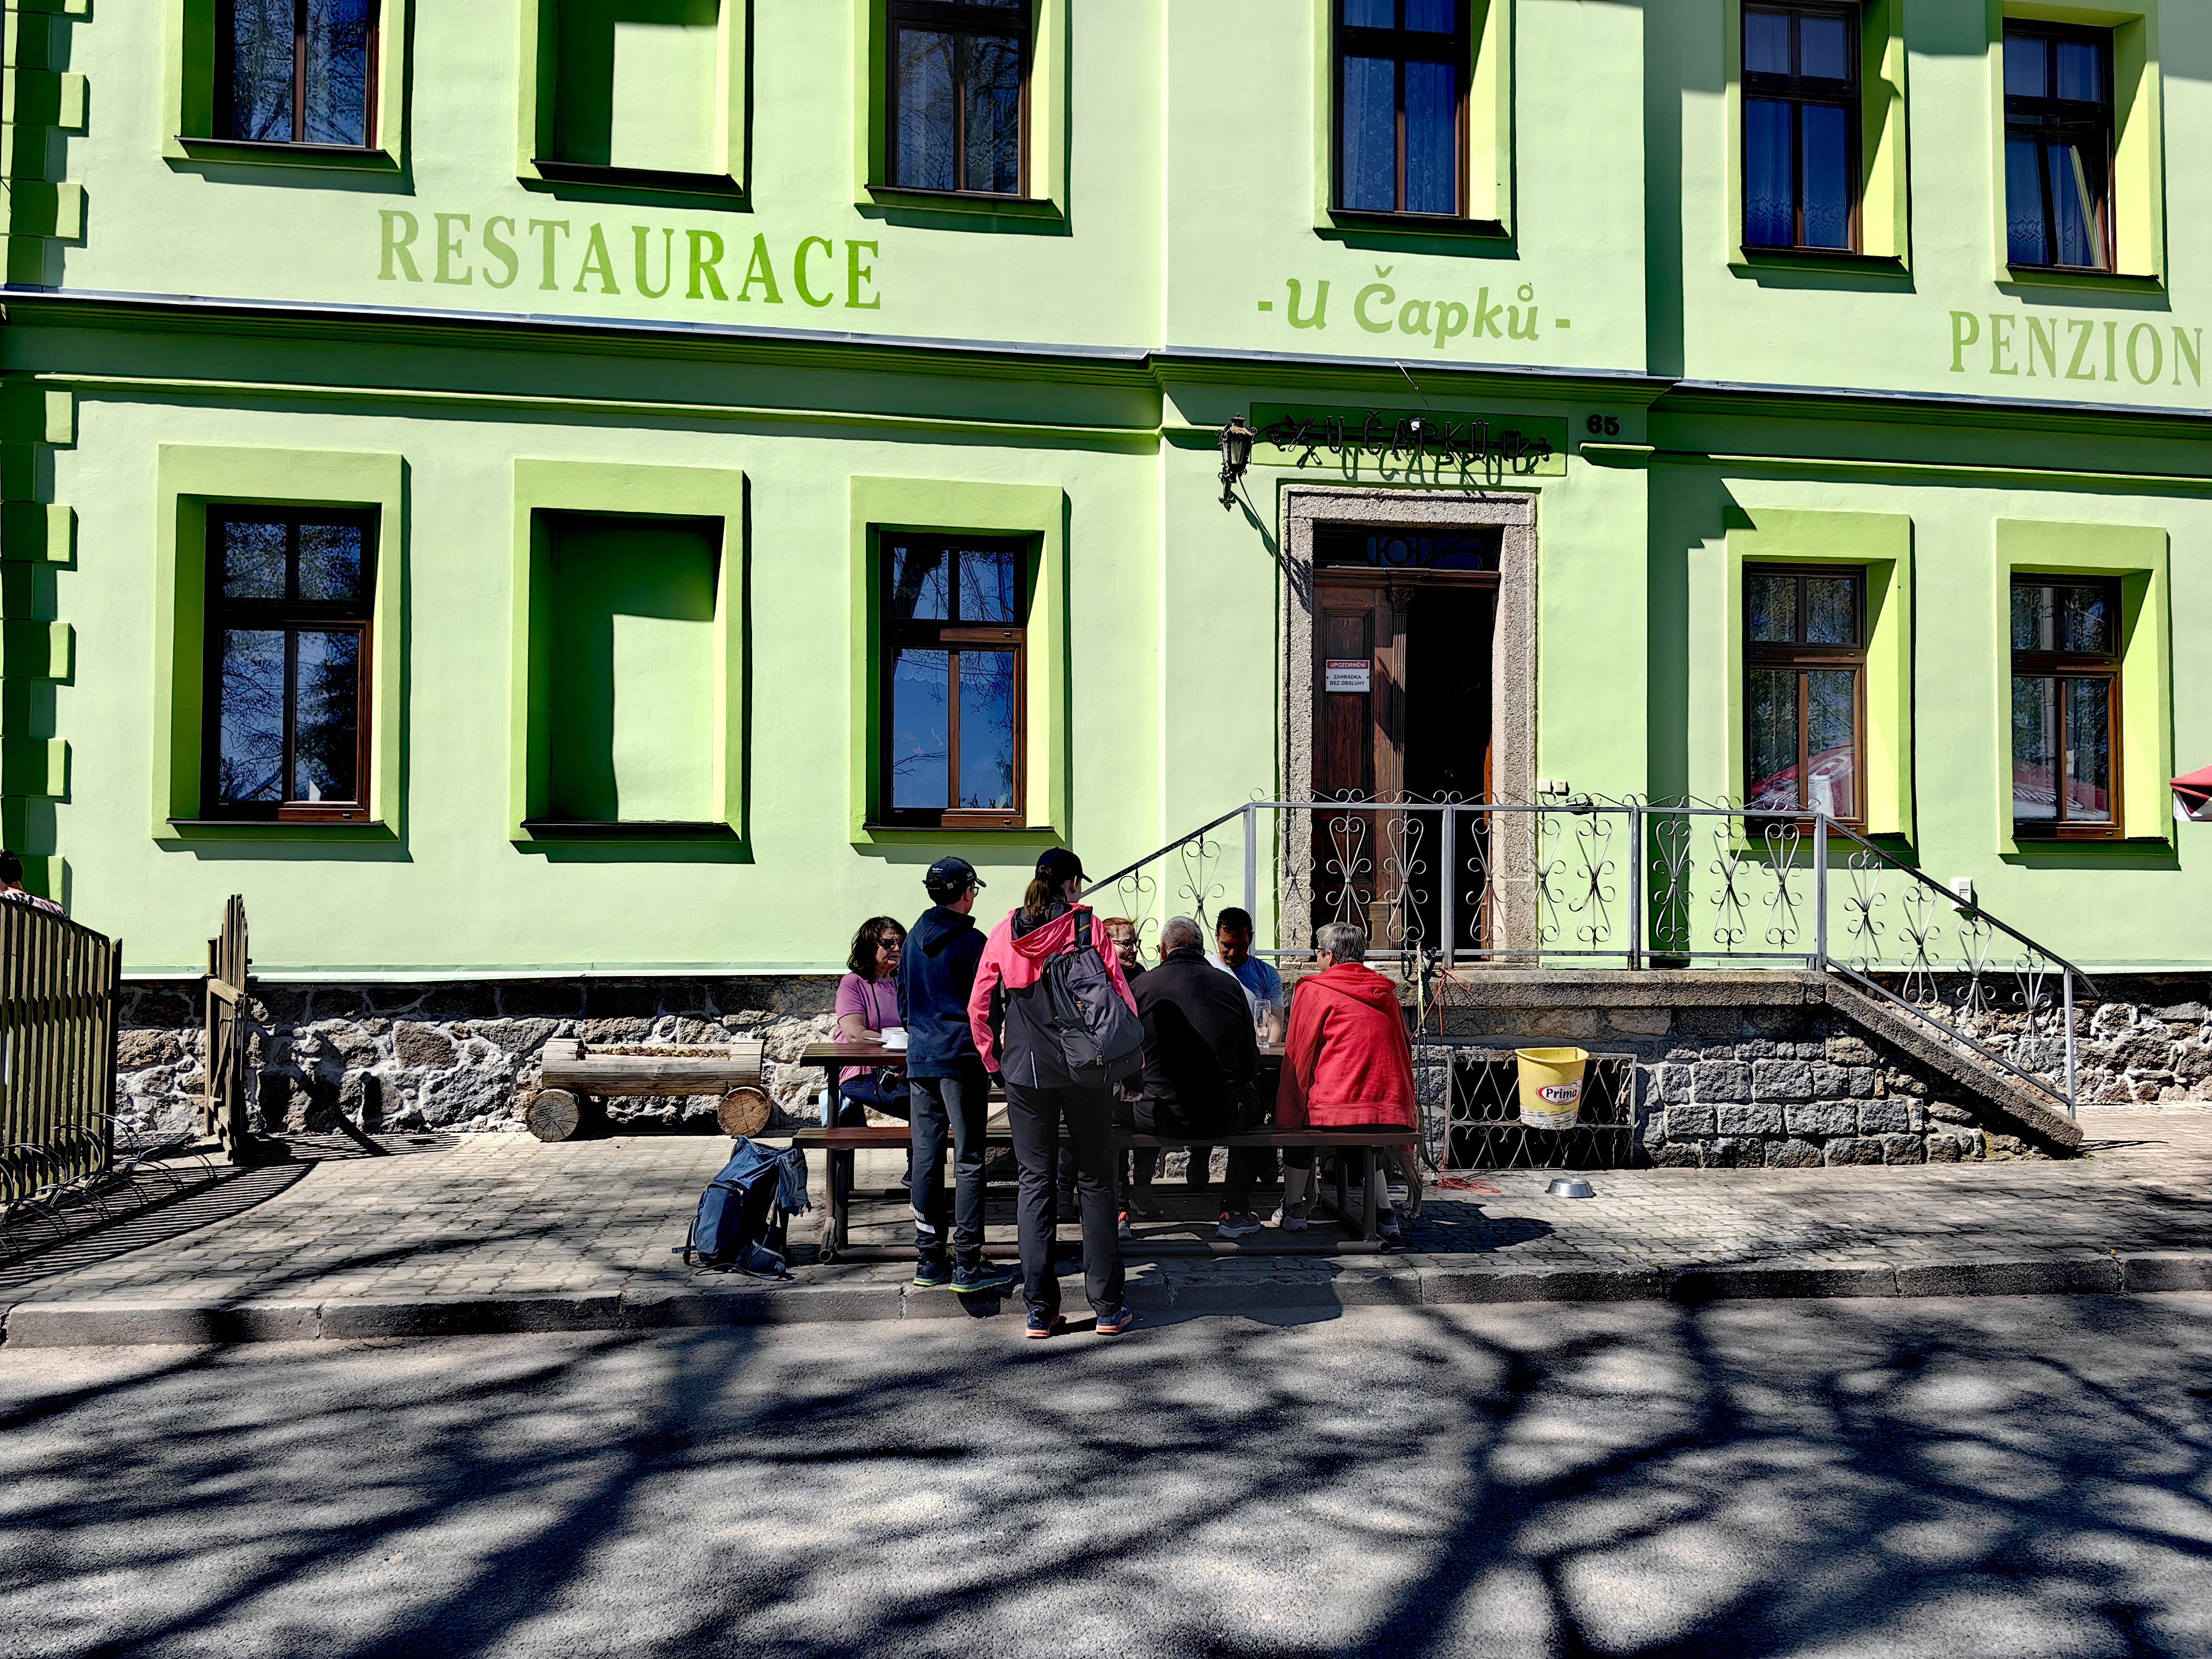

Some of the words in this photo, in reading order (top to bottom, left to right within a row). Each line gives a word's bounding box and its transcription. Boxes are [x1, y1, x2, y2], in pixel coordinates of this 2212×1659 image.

[377, 209, 880, 310] RESTAURACE
[1949, 310, 2203, 387] PENZION
[1327, 415, 1344, 454] U
[1364, 410, 1489, 460] ČAPKŮ
[1587, 414, 1620, 436] 65
[1546, 1088, 1577, 1099] Prima
